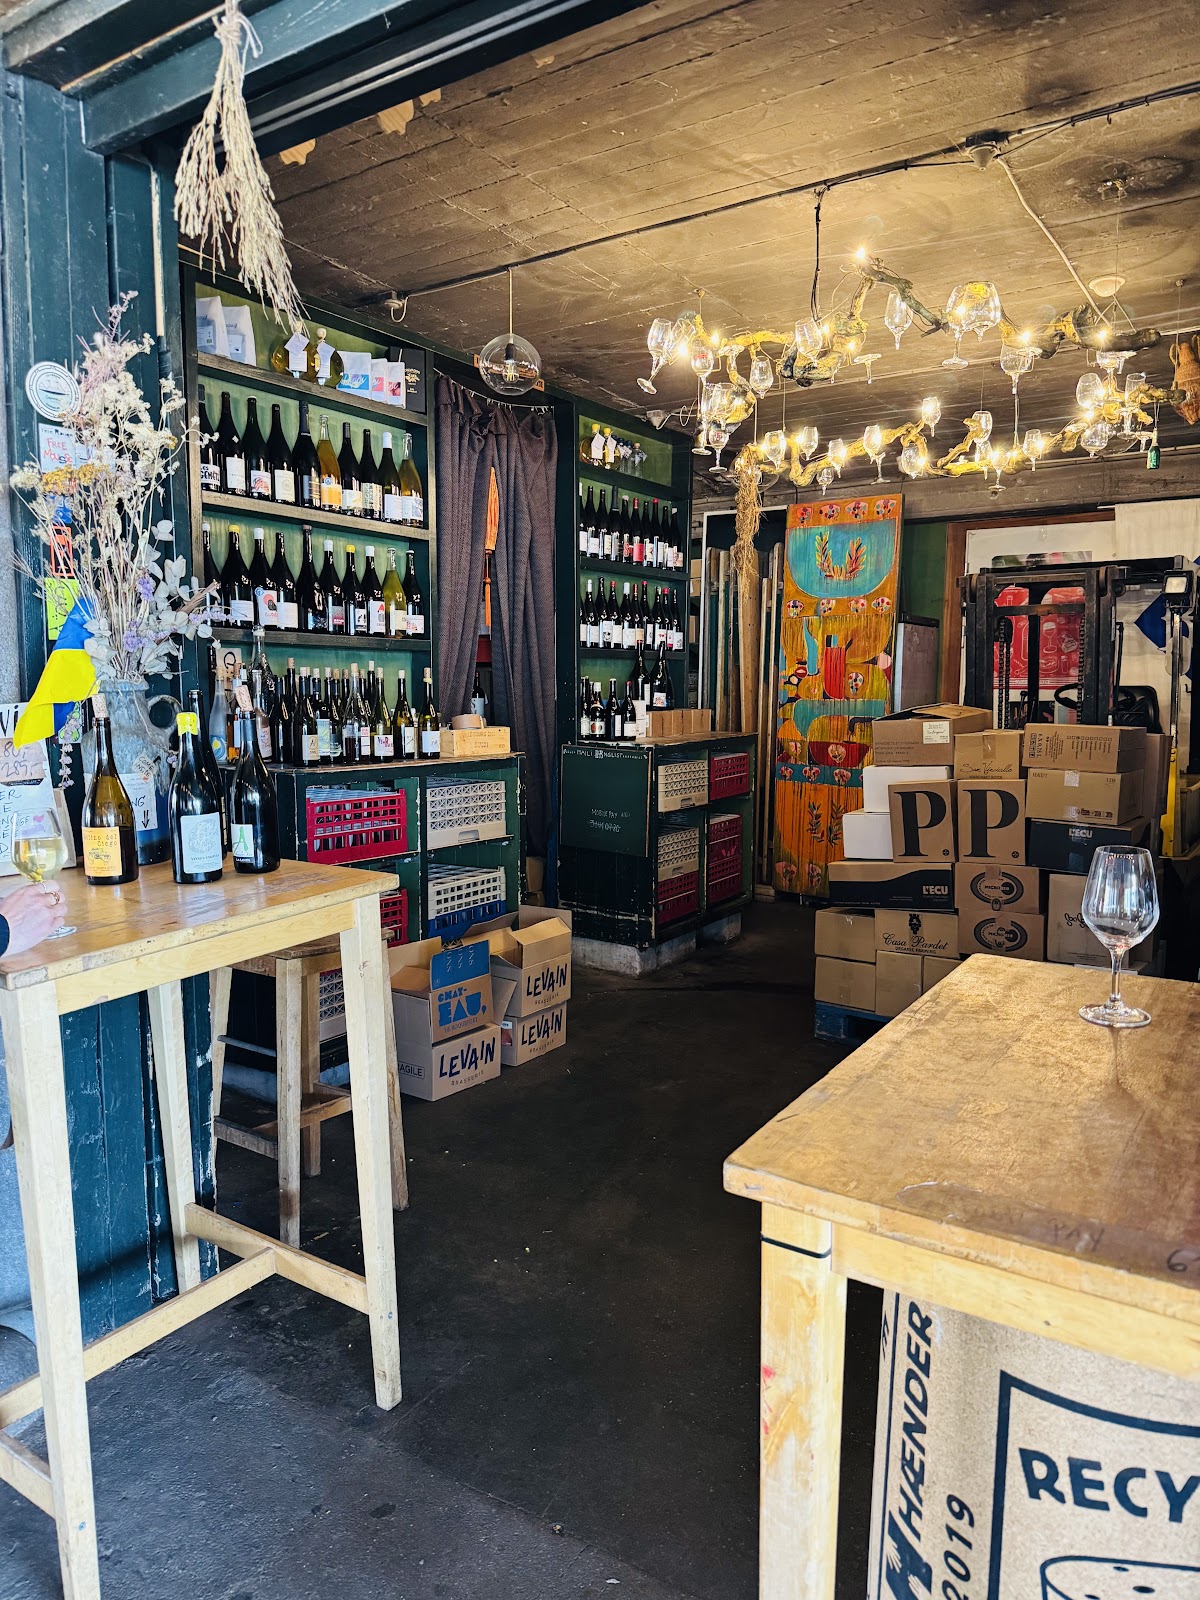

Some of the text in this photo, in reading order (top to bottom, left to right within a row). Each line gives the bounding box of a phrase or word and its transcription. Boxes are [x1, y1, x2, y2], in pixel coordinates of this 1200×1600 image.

[922, 885, 949, 895] L'ECU
[882, 932, 949, 951] Casa Pardet
[526, 963, 568, 997] LEVAIN
[521, 1008, 563, 1046] LEVAIN
[439, 1036, 496, 1078] LEVAIN
[451, 1069, 485, 1086] BRASSERIE
[899, 1301, 933, 1542] HÆNDER
[1018, 1446, 1200, 1524] RECY
